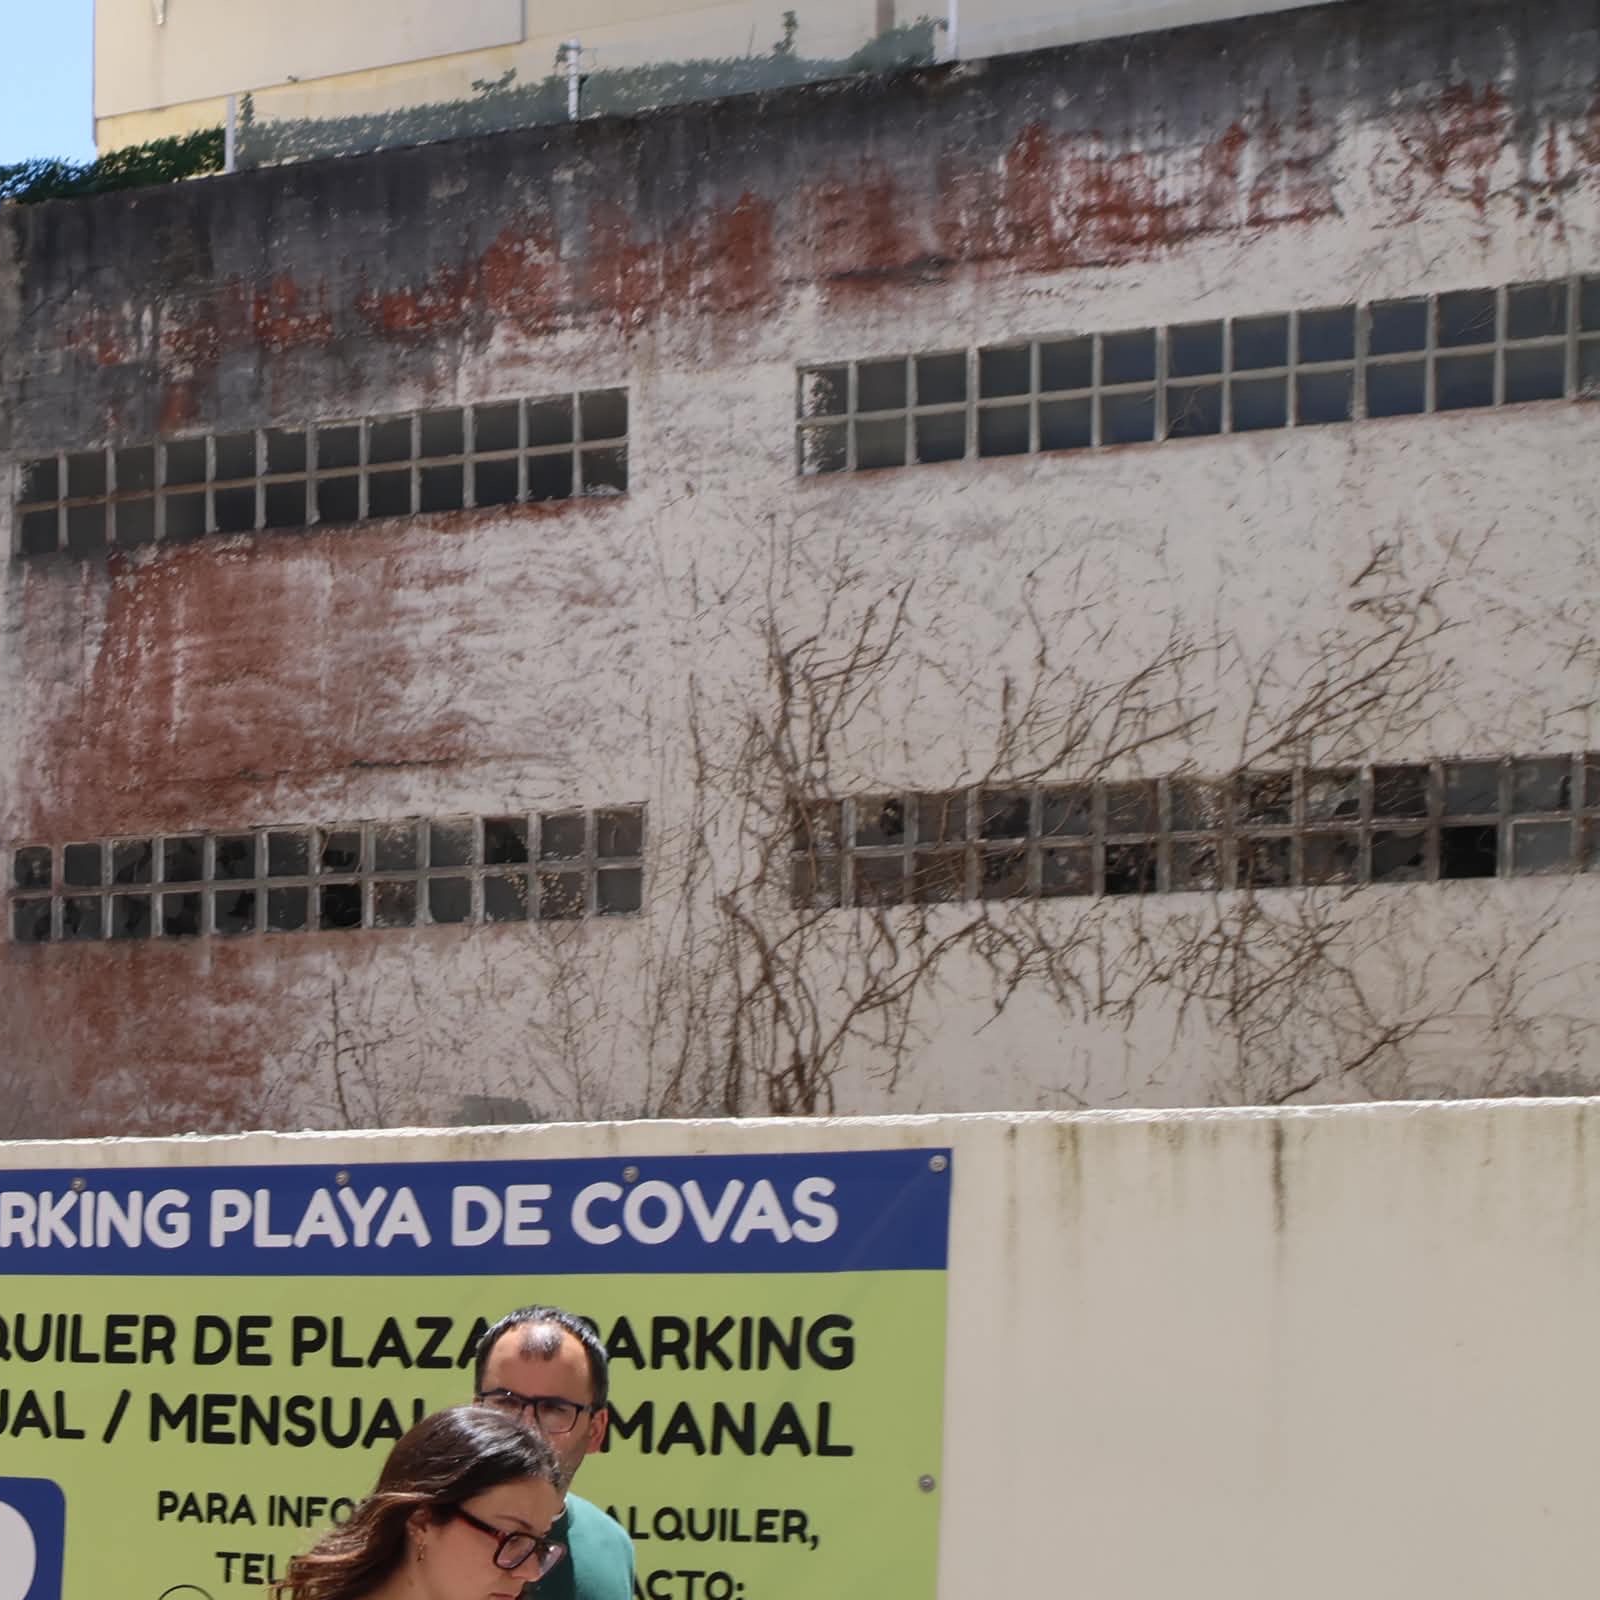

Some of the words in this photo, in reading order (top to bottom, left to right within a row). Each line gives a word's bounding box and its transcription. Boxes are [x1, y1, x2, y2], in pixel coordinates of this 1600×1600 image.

[209, 1186, 432, 1248] PLAYA
[450, 1183, 552, 1247] DE
[570, 1176, 839, 1245] COVAS
[193, 1314, 273, 1367] DE
[291, 1315, 490, 1369] PLAZA
[581, 1314, 855, 1370] ARKING
[102, 1388, 132, 1444] /
[602, 1400, 854, 1457] MANAL
[157, 1490, 257, 1526] PARA
[268, 1495, 360, 1528] INFO
